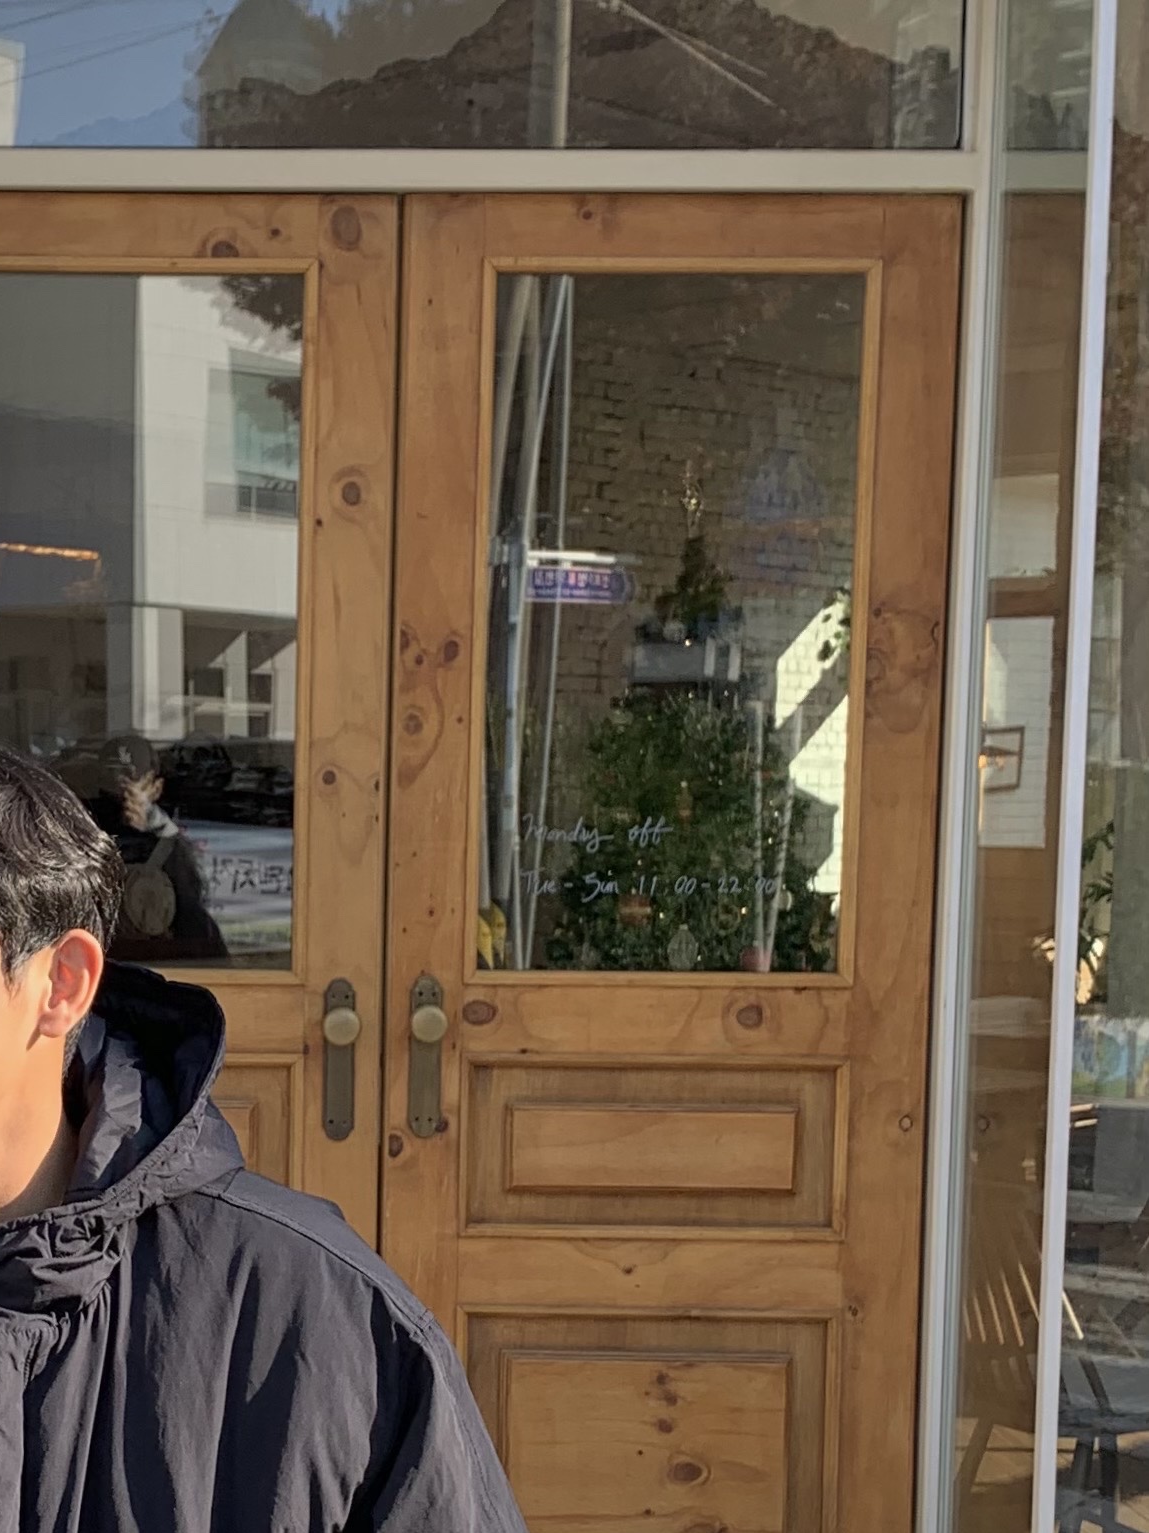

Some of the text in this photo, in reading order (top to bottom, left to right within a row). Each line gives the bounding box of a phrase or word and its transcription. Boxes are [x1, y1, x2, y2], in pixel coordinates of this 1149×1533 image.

[523, 813, 674, 853] Monday off
[520, 868, 557, 895] Tue
